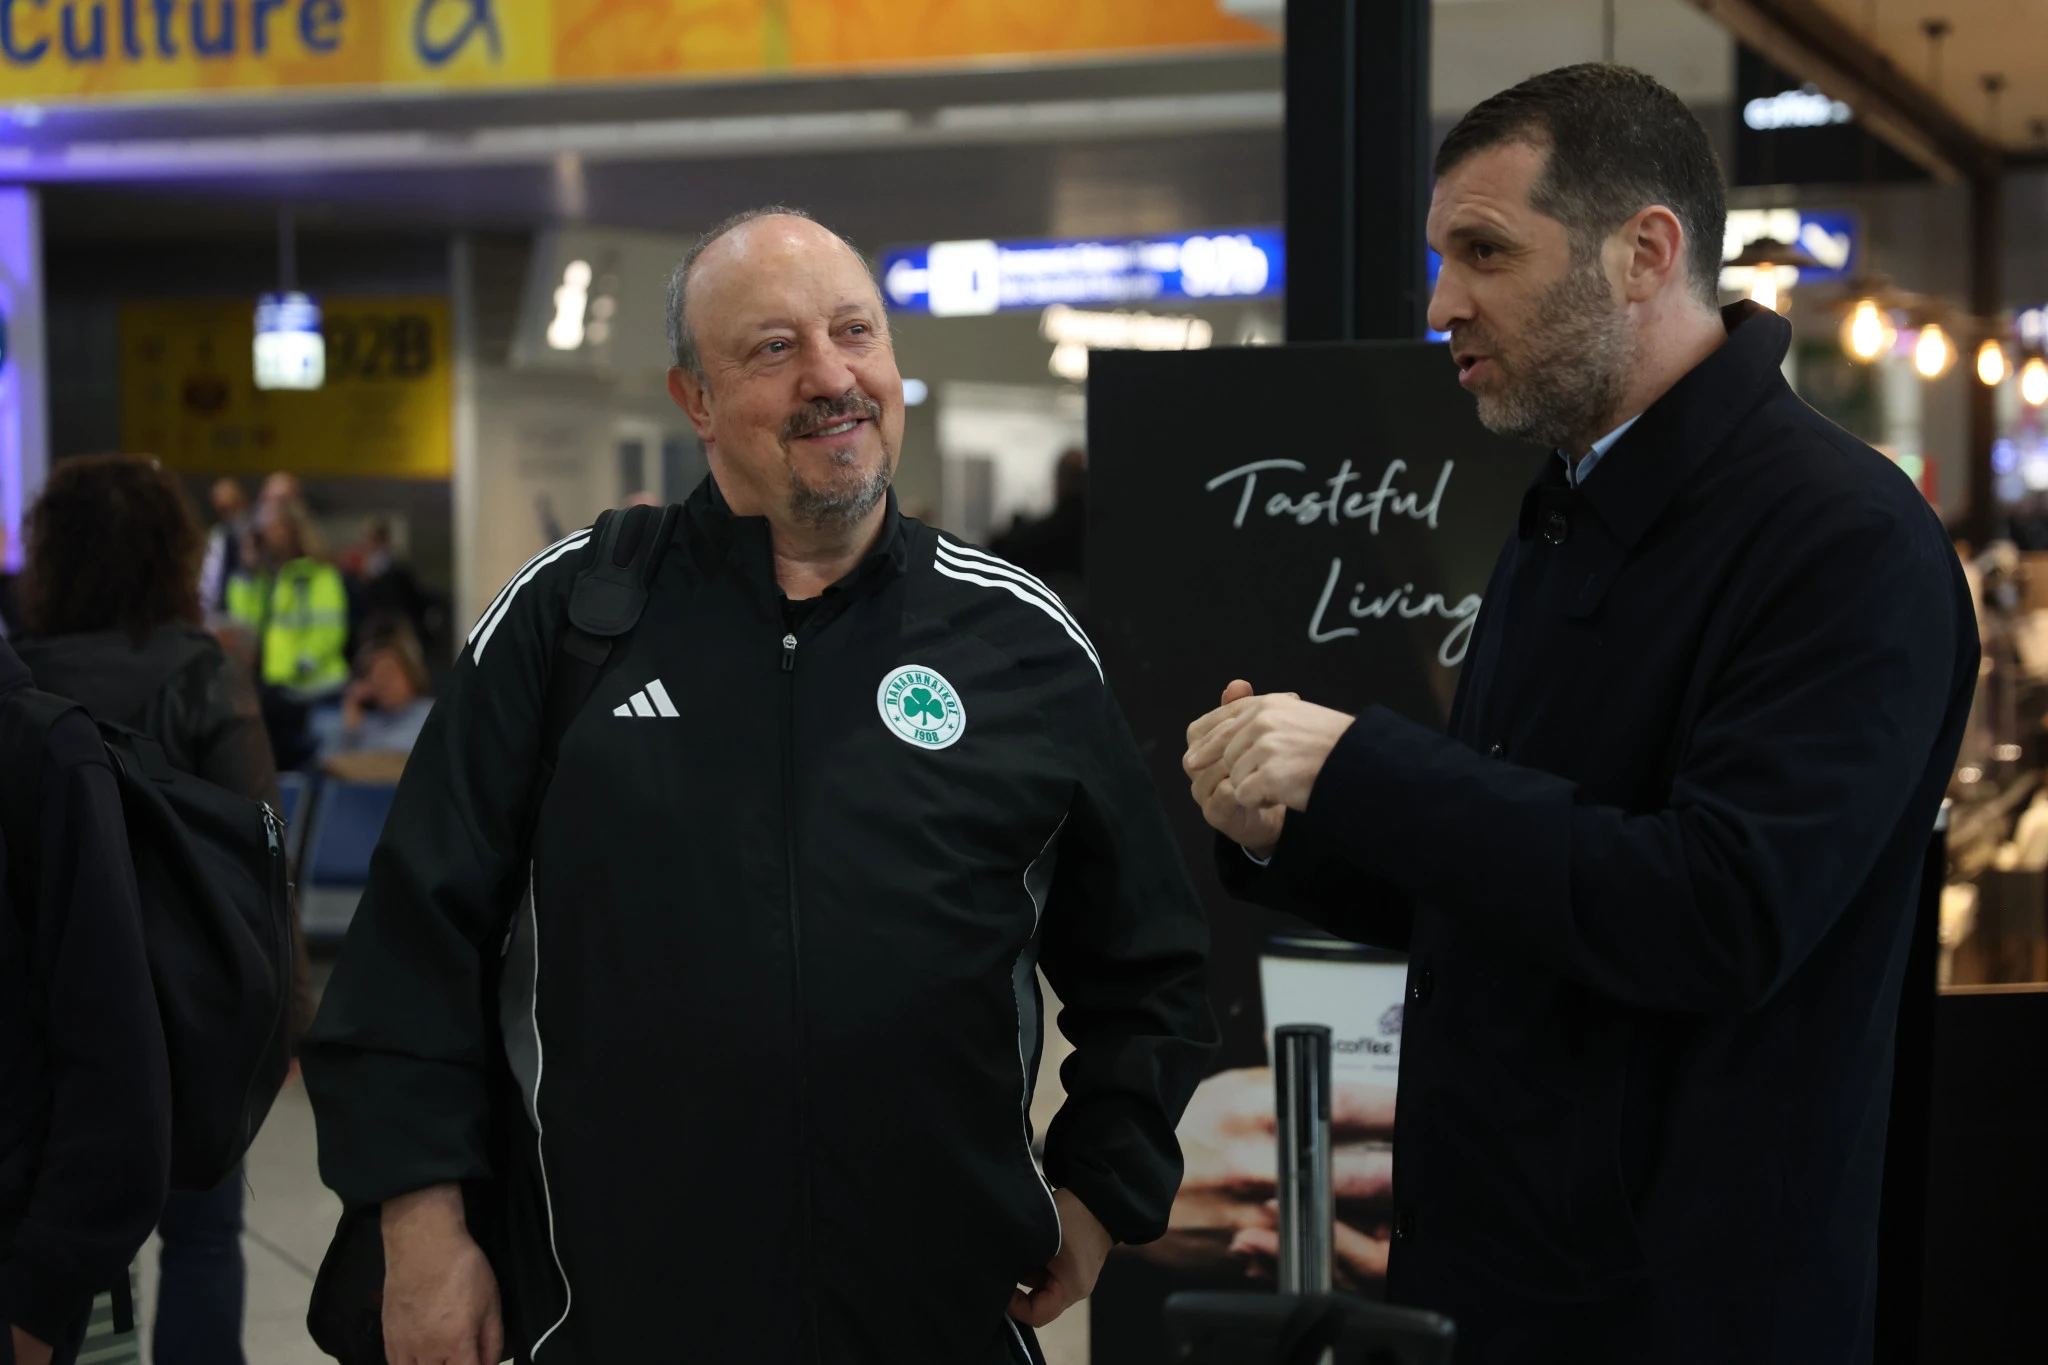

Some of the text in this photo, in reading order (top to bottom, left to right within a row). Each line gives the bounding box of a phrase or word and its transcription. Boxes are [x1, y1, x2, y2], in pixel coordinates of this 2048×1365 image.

[0, 0, 344, 63] Culture
[1205, 458, 1453, 535] Tasteful
[1308, 557, 1483, 667] Living
[914, 729, 939, 742] 1908
